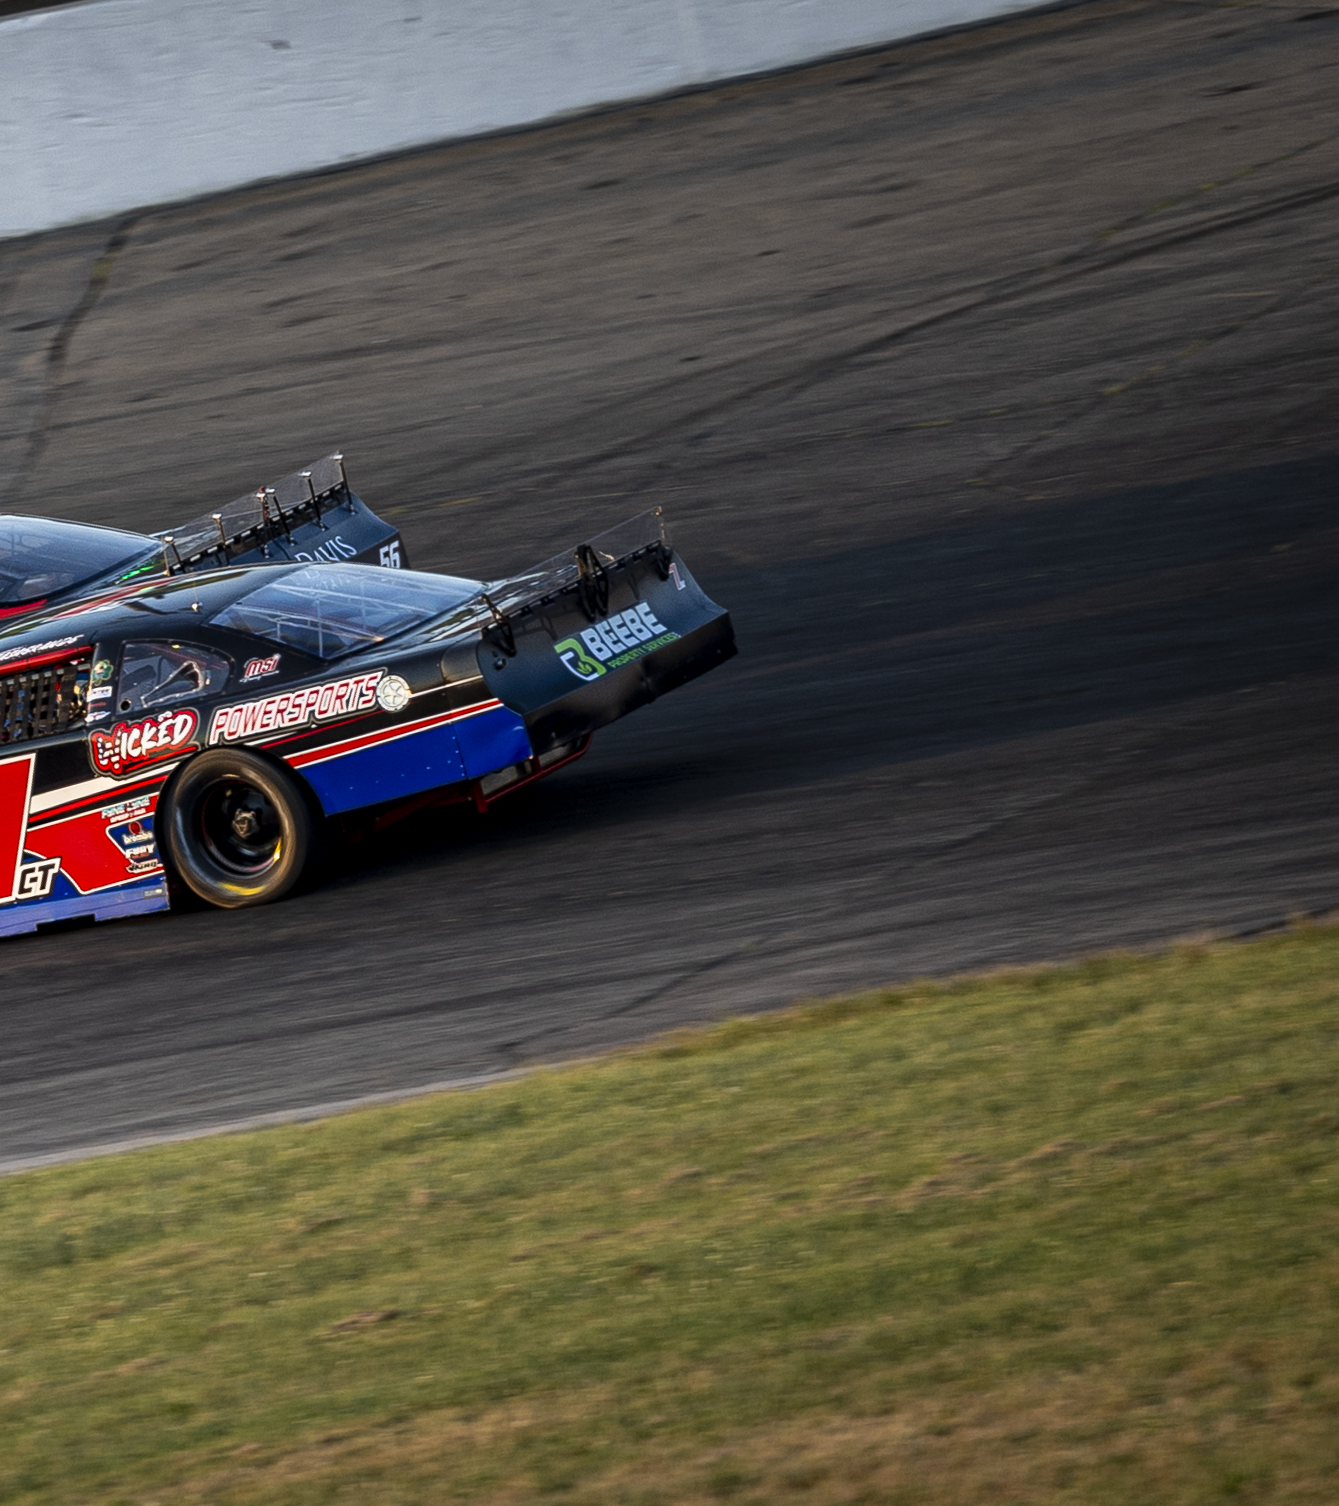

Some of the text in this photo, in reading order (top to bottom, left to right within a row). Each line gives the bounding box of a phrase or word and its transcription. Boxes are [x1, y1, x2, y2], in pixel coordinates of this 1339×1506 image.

[379, 540, 400, 569] 56
[580, 601, 668, 662] BEEBE
[209, 671, 381, 746] POWERSPORTS
[96, 710, 194, 771] WICKED
